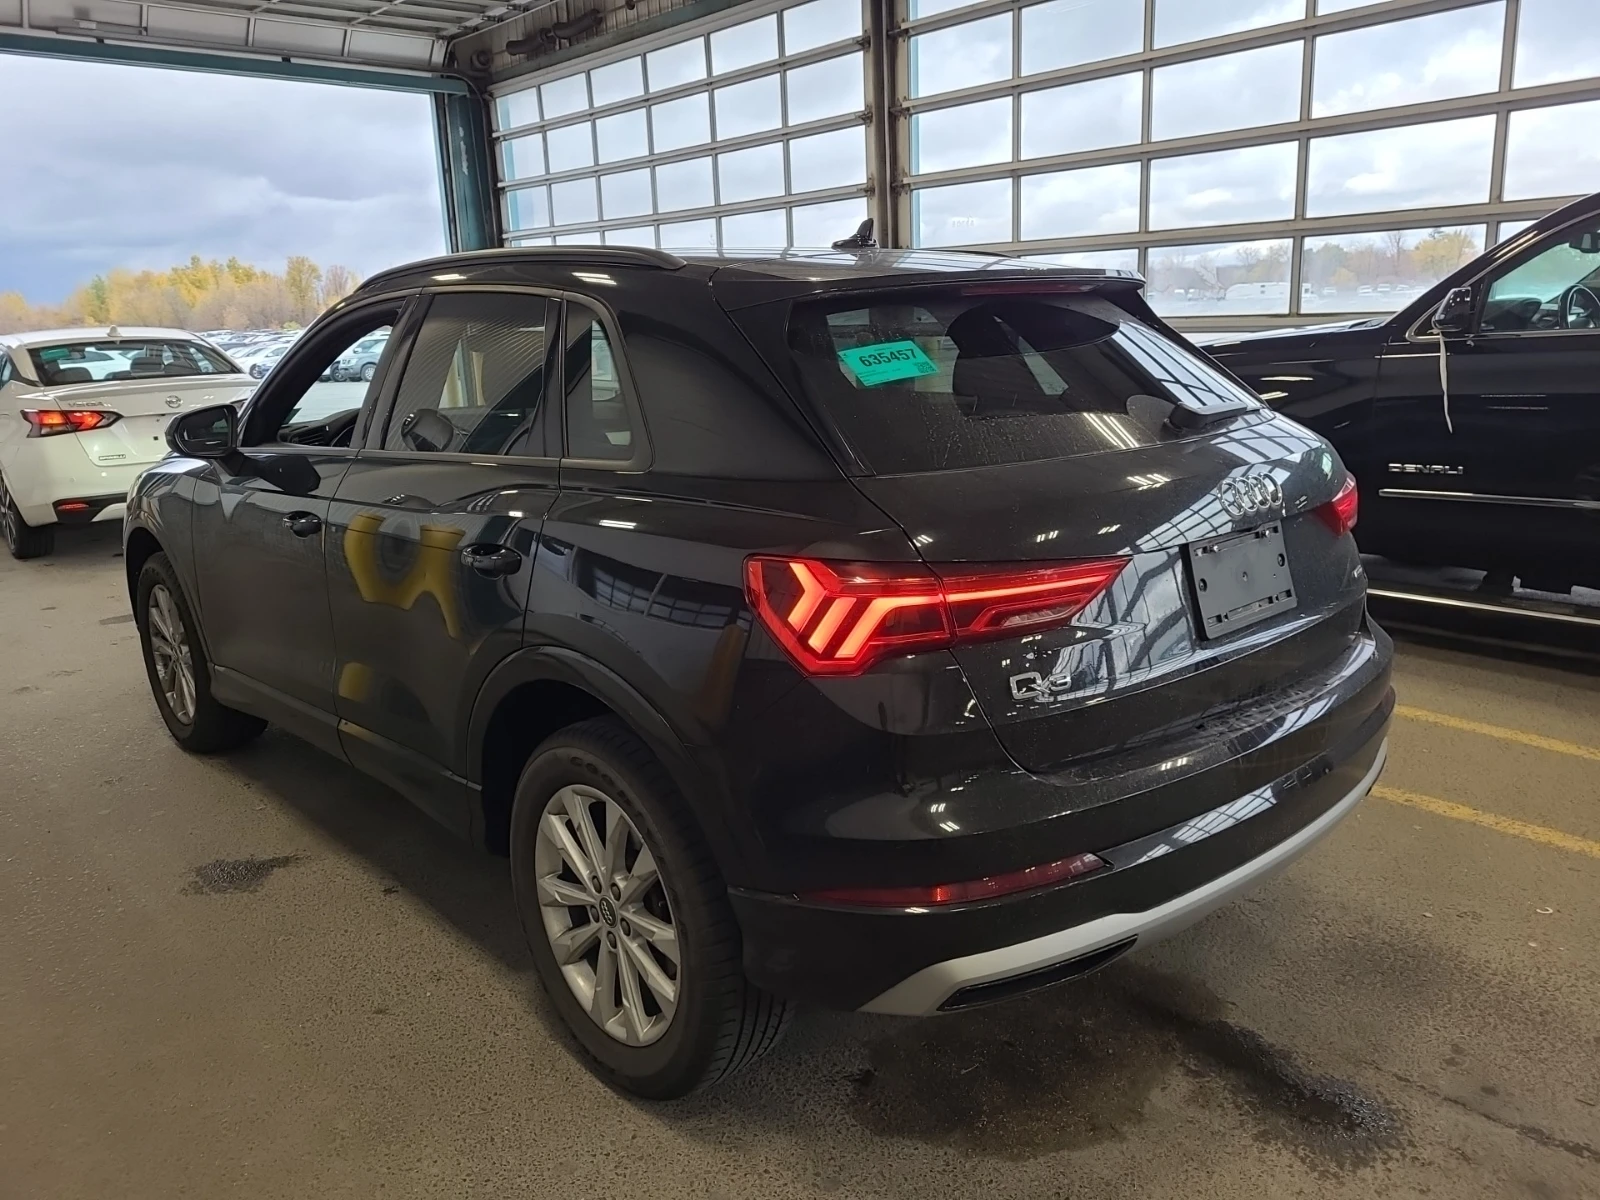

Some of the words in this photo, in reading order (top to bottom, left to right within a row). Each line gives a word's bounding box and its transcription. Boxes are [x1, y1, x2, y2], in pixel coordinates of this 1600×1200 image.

[859, 348, 918, 367] 635457
[1388, 463, 1464, 475] DENALI
[1009, 671, 1072, 700] Q3
